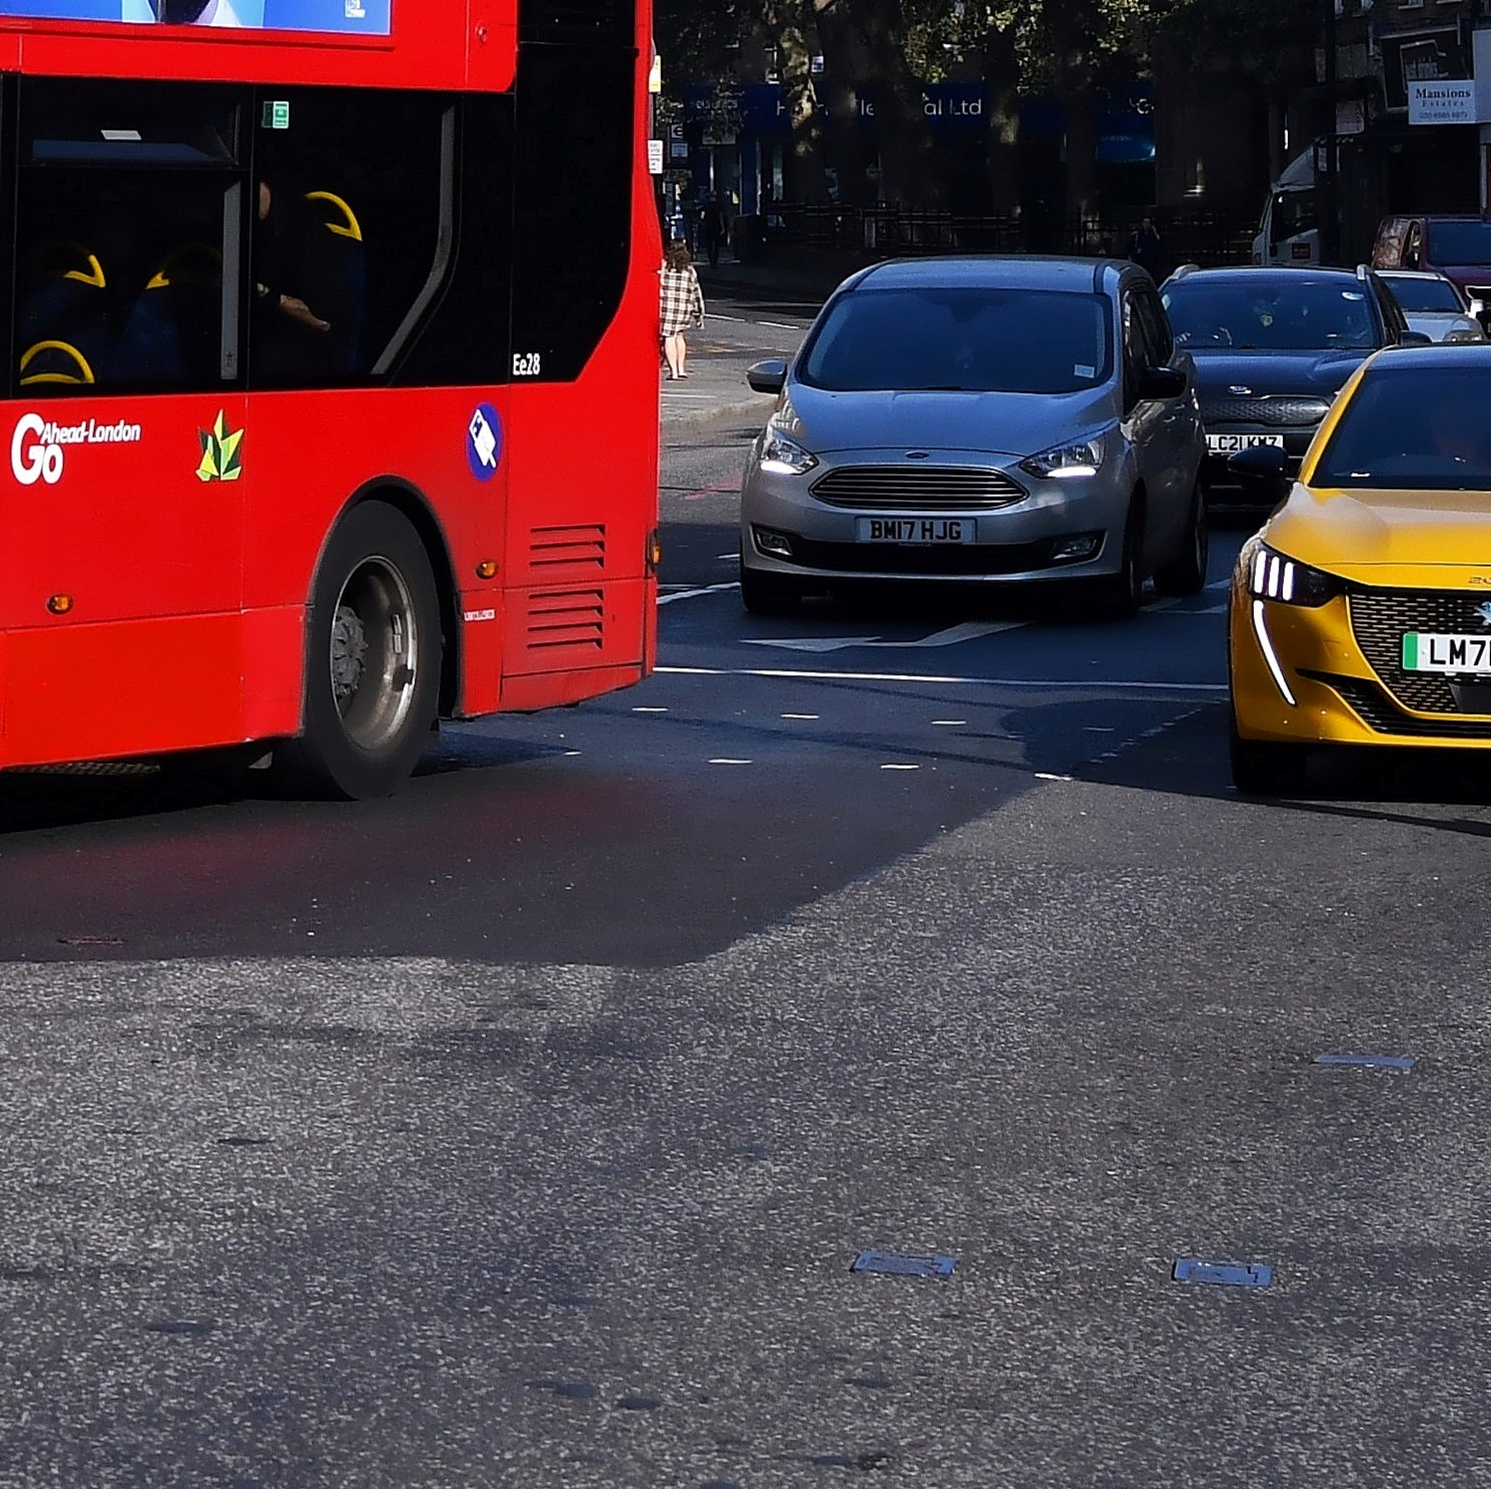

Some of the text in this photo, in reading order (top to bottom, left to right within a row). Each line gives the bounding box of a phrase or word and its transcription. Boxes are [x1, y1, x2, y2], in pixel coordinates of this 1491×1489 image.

[1415, 87, 1472, 100] Mansions
[1421, 100, 1465, 108] Estates
[512, 353, 541, 376] Ee28
[10, 412, 142, 485] Go Ahead-London
[870, 520, 962, 541] BM17 HJG
[1429, 638, 1491, 667] LM7
